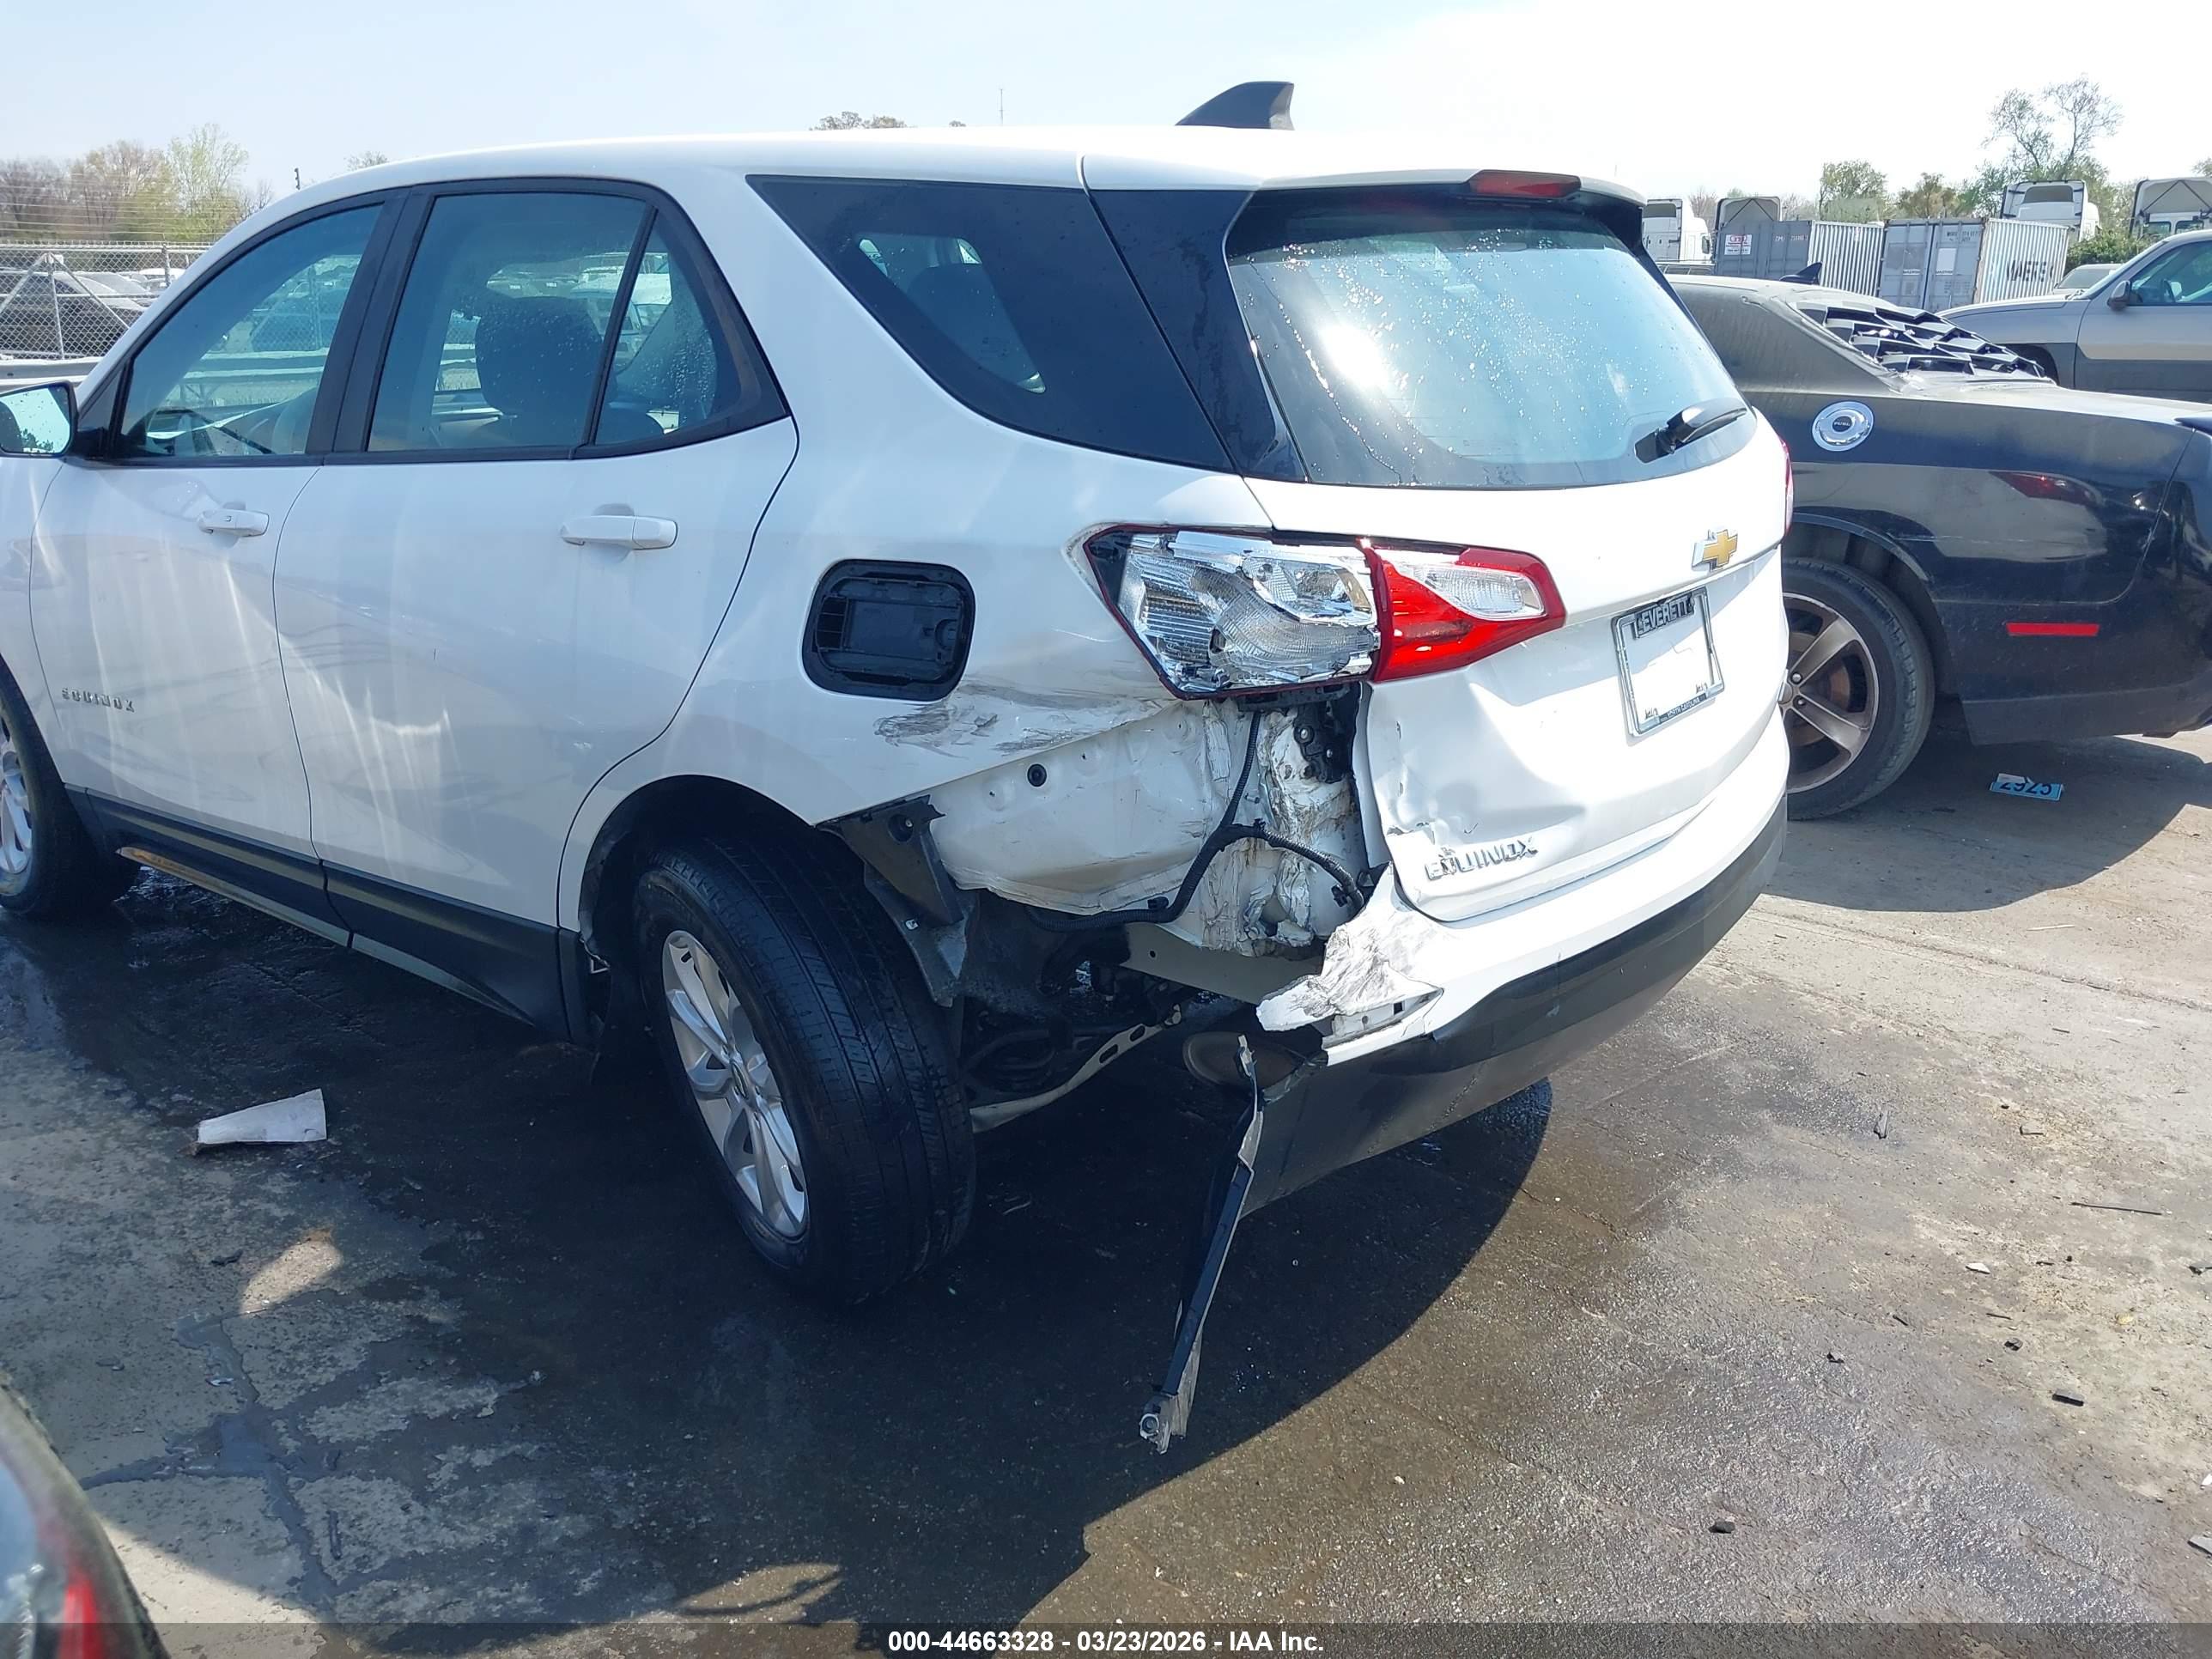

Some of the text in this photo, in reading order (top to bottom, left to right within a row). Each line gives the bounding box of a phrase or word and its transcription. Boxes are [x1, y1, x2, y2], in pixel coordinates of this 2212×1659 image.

[61, 687, 135, 713] EQUINOX
[1667, 696, 1701, 719] NORTH CAROLINA
[1425, 836, 1539, 881] EQUINOX
